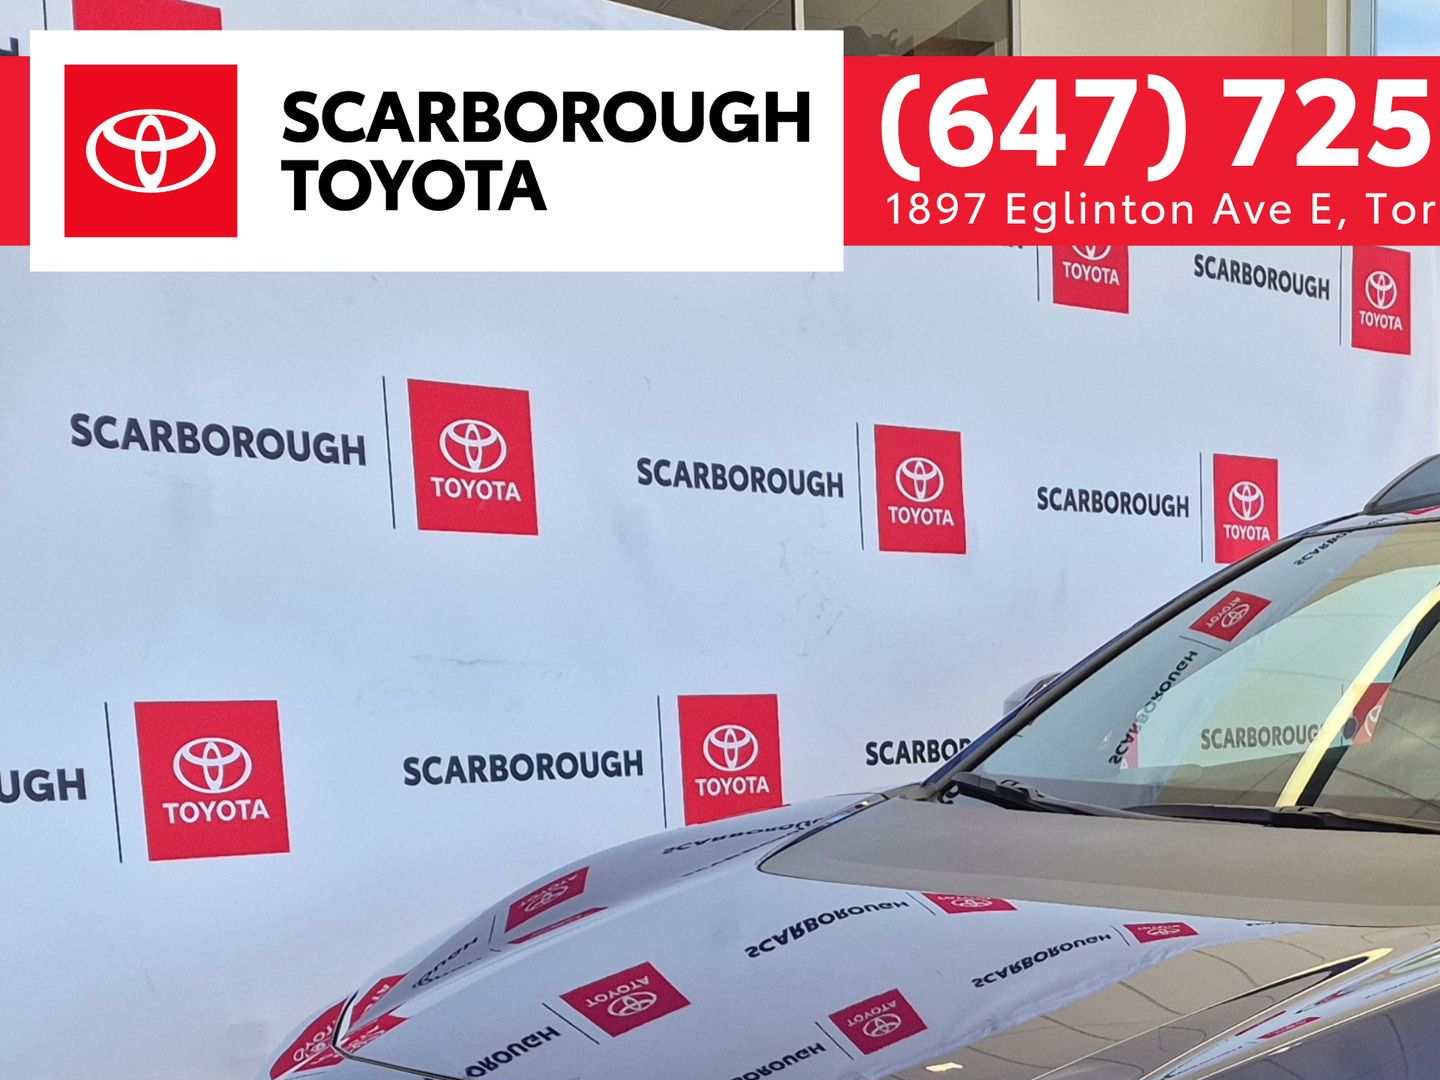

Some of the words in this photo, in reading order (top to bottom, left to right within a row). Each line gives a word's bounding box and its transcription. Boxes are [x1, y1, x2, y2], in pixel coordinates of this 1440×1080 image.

[1062, 260, 1120, 286] TOYOTA
[1193, 253, 1330, 301] SCARBOROUGH
[1359, 310, 1403, 331] TOYOTA
[70, 413, 367, 466] SCARBOROUGH
[430, 476, 522, 503] TOYOTA
[636, 457, 844, 499] SCARBOROUGH
[887, 504, 955, 527] TOYOTA
[1037, 486, 1189, 518] SCARBOROUGH
[1223, 523, 1271, 542] TOYOTA
[1201, 723, 1324, 751] SCARBOROUG
[403, 749, 644, 787] SCARBOROUGH
[694, 775, 770, 797] TOYOTA
[162, 798, 270, 824] TOYOTA
